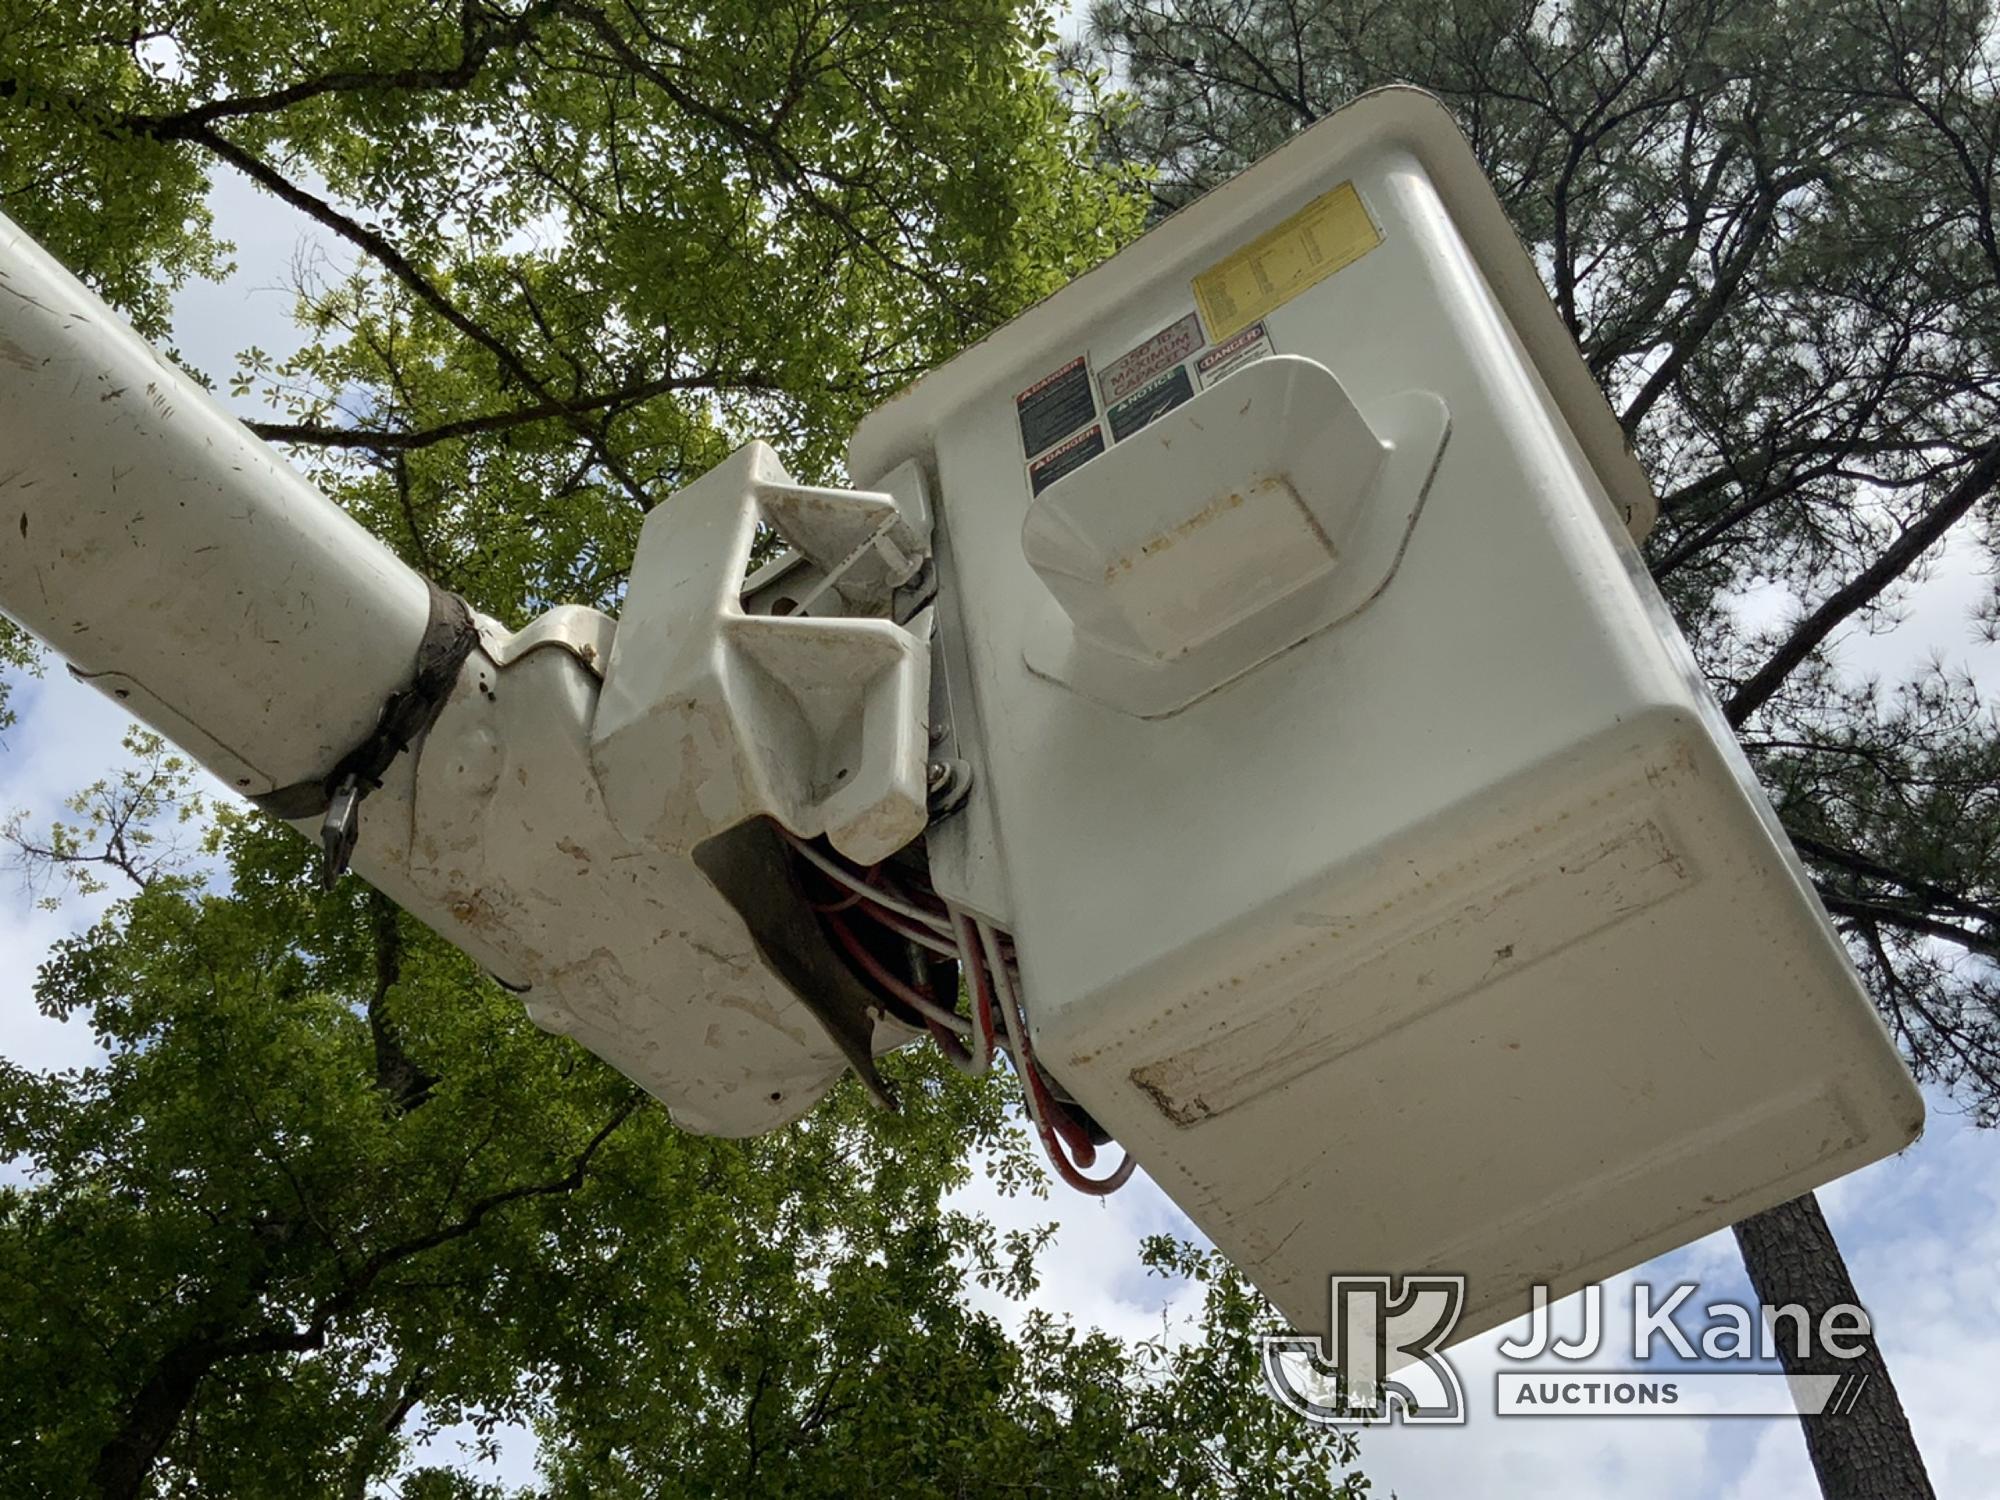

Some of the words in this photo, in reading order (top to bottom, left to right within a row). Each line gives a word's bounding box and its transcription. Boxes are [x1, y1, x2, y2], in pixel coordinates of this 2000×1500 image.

[1111, 333, 1189, 385] MAXIMUM
[1206, 329, 1254, 364] DANGER
[1033, 360, 1079, 393] DANGER
[1114, 344, 1190, 395] CAPACITY
[1128, 373, 1177, 405] NOTICE
[1048, 428, 1095, 462] DANGER
